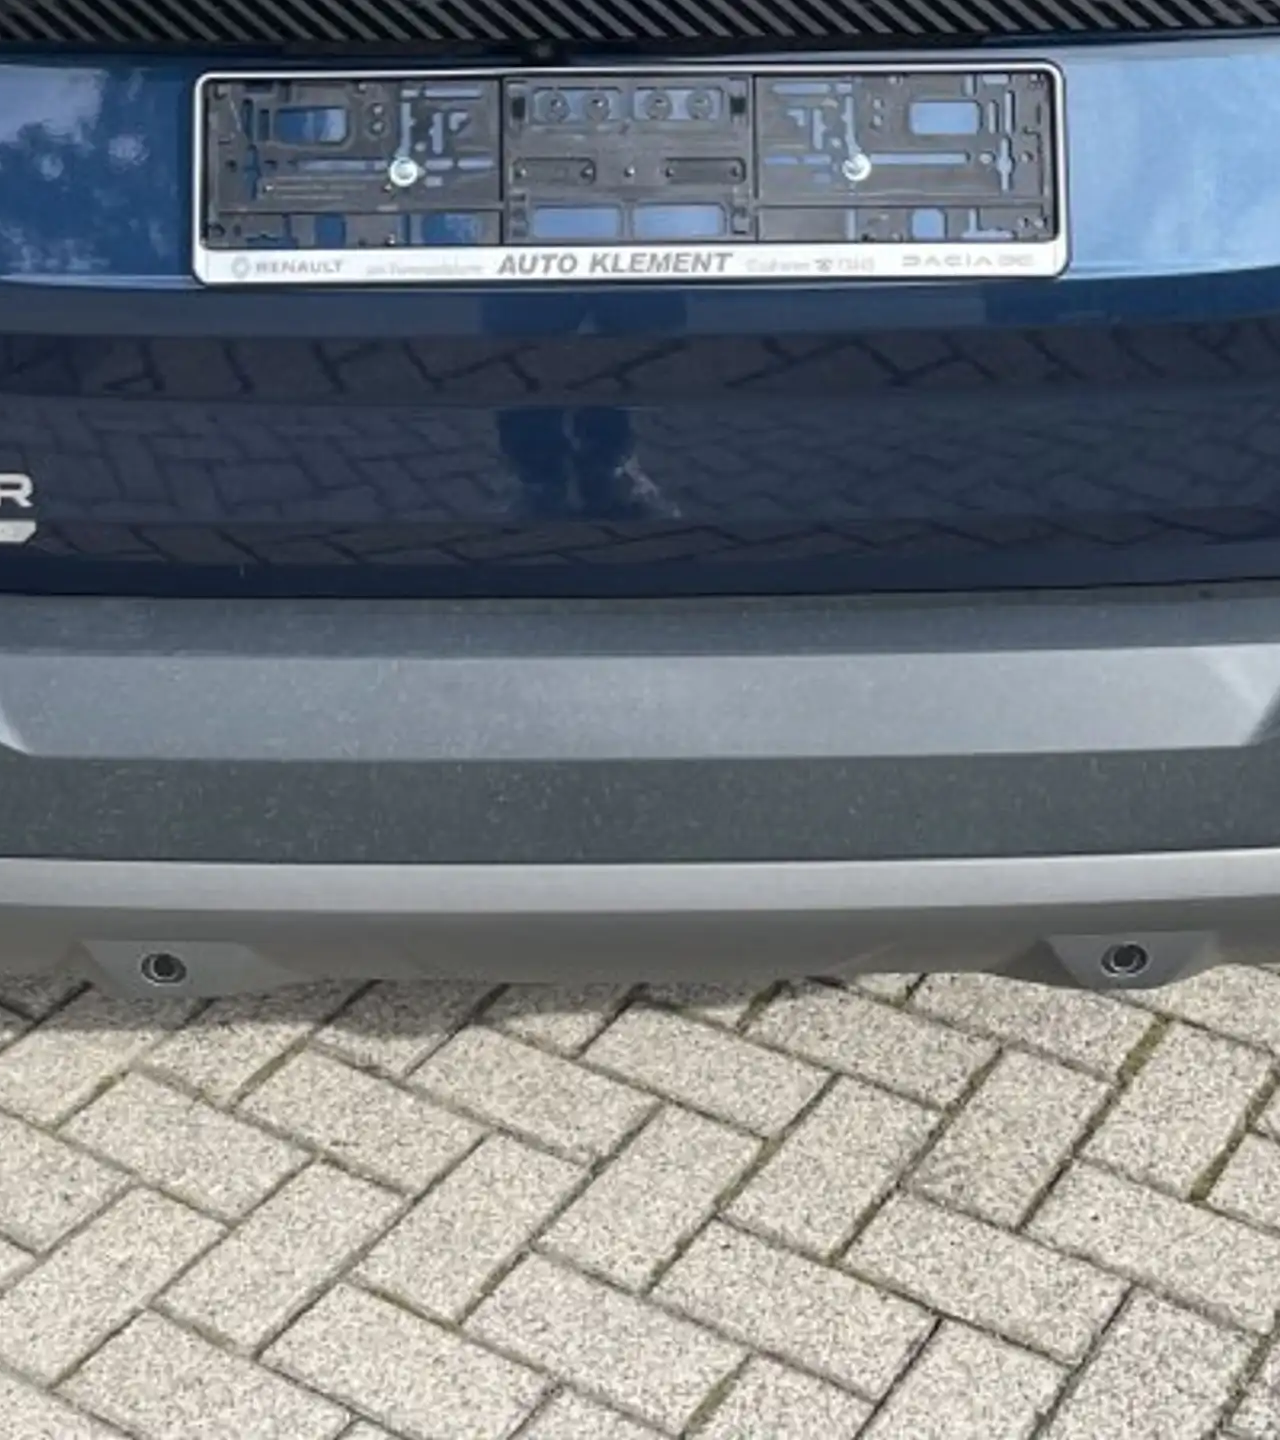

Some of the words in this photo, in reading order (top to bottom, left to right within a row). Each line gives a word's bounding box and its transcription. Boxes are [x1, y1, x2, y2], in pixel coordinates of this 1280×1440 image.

[256, 259, 343, 274] RENAULT
[497, 252, 579, 276] AUTO
[588, 251, 734, 274] KLEMENT
[901, 253, 993, 268] DACIA
